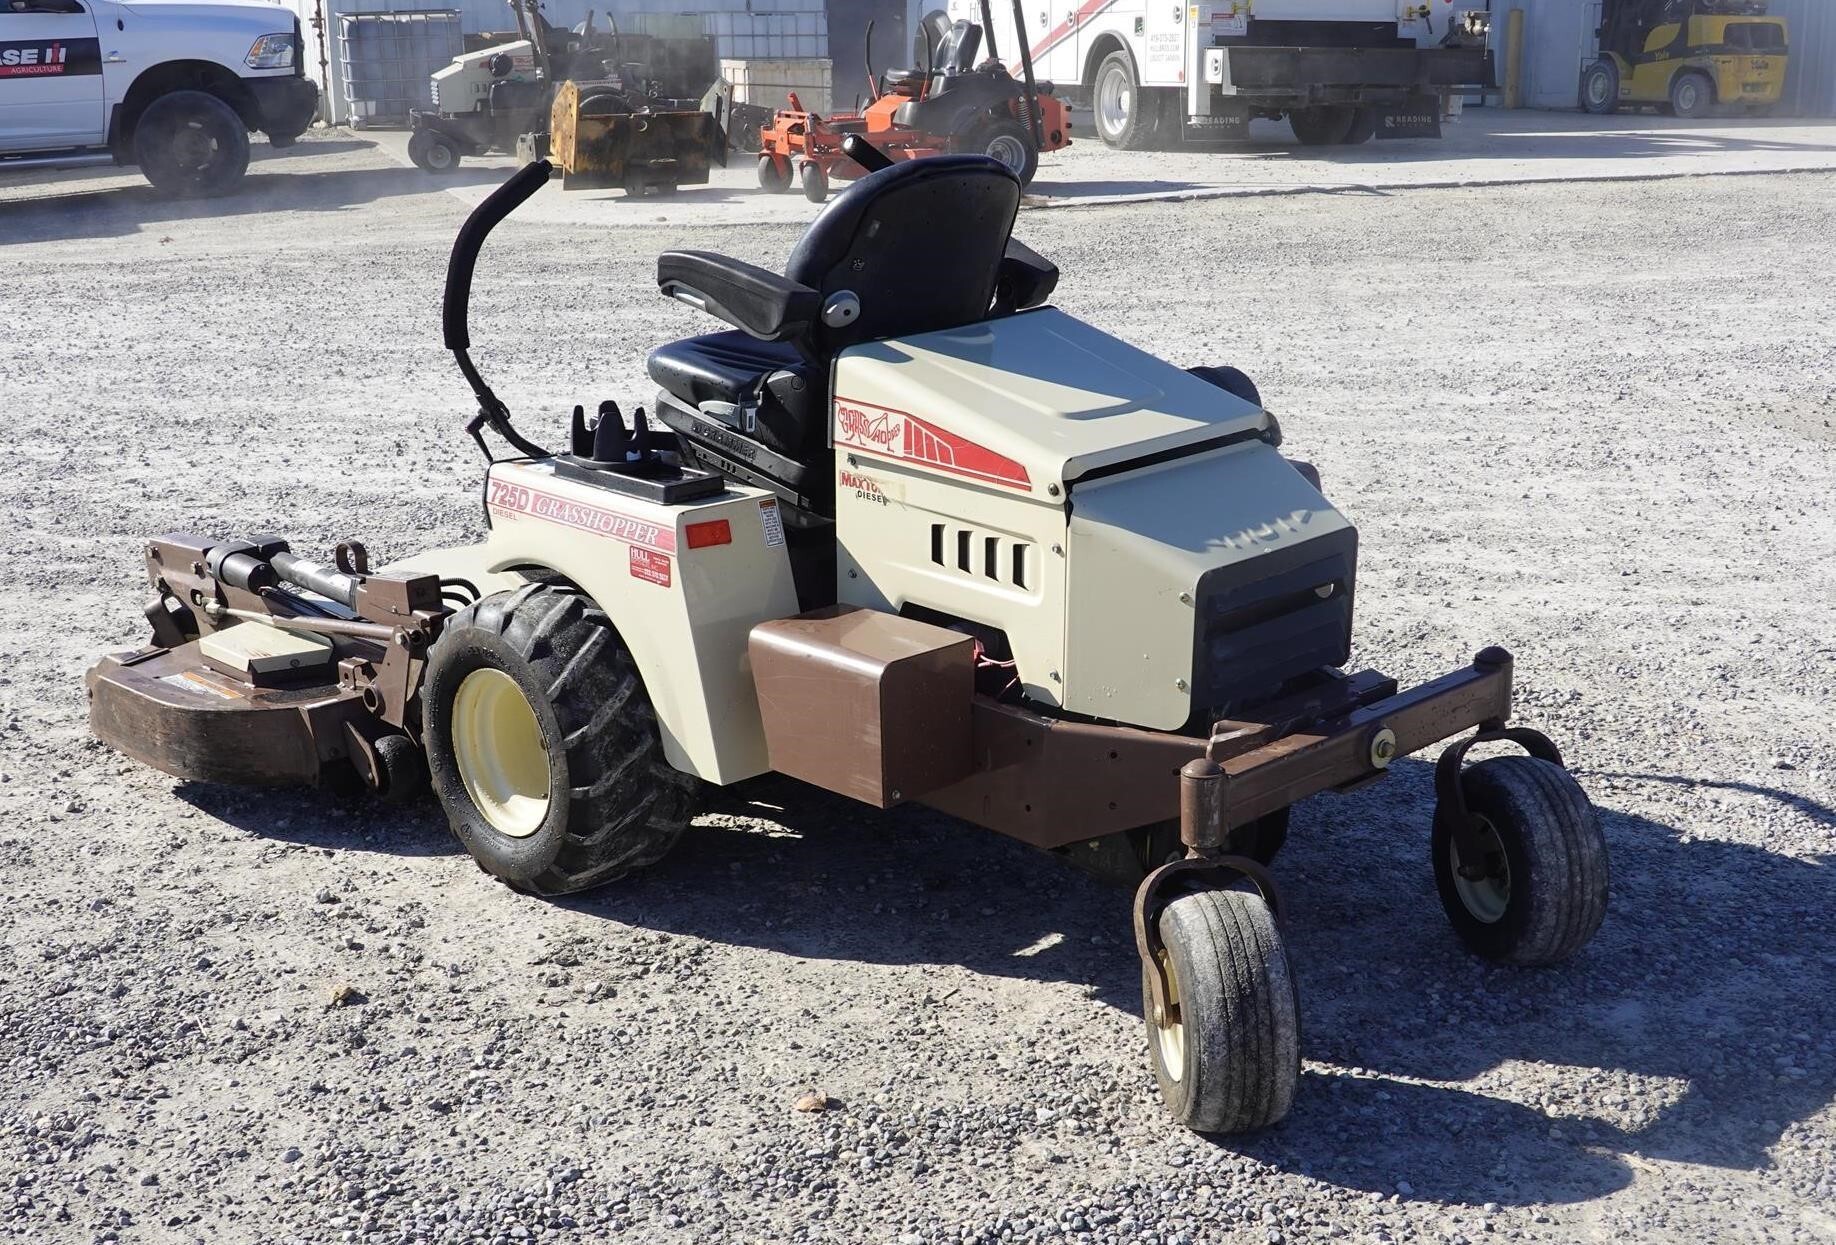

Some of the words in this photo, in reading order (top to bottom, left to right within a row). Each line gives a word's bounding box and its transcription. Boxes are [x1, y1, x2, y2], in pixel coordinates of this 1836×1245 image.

[11, 65, 63, 74] AGRICULTURE
[491, 483, 530, 510] 725D
[536, 496, 659, 546] GRASSHOPPER
[492, 508, 518, 521] DIESEL
[631, 547, 650, 561] HULL
